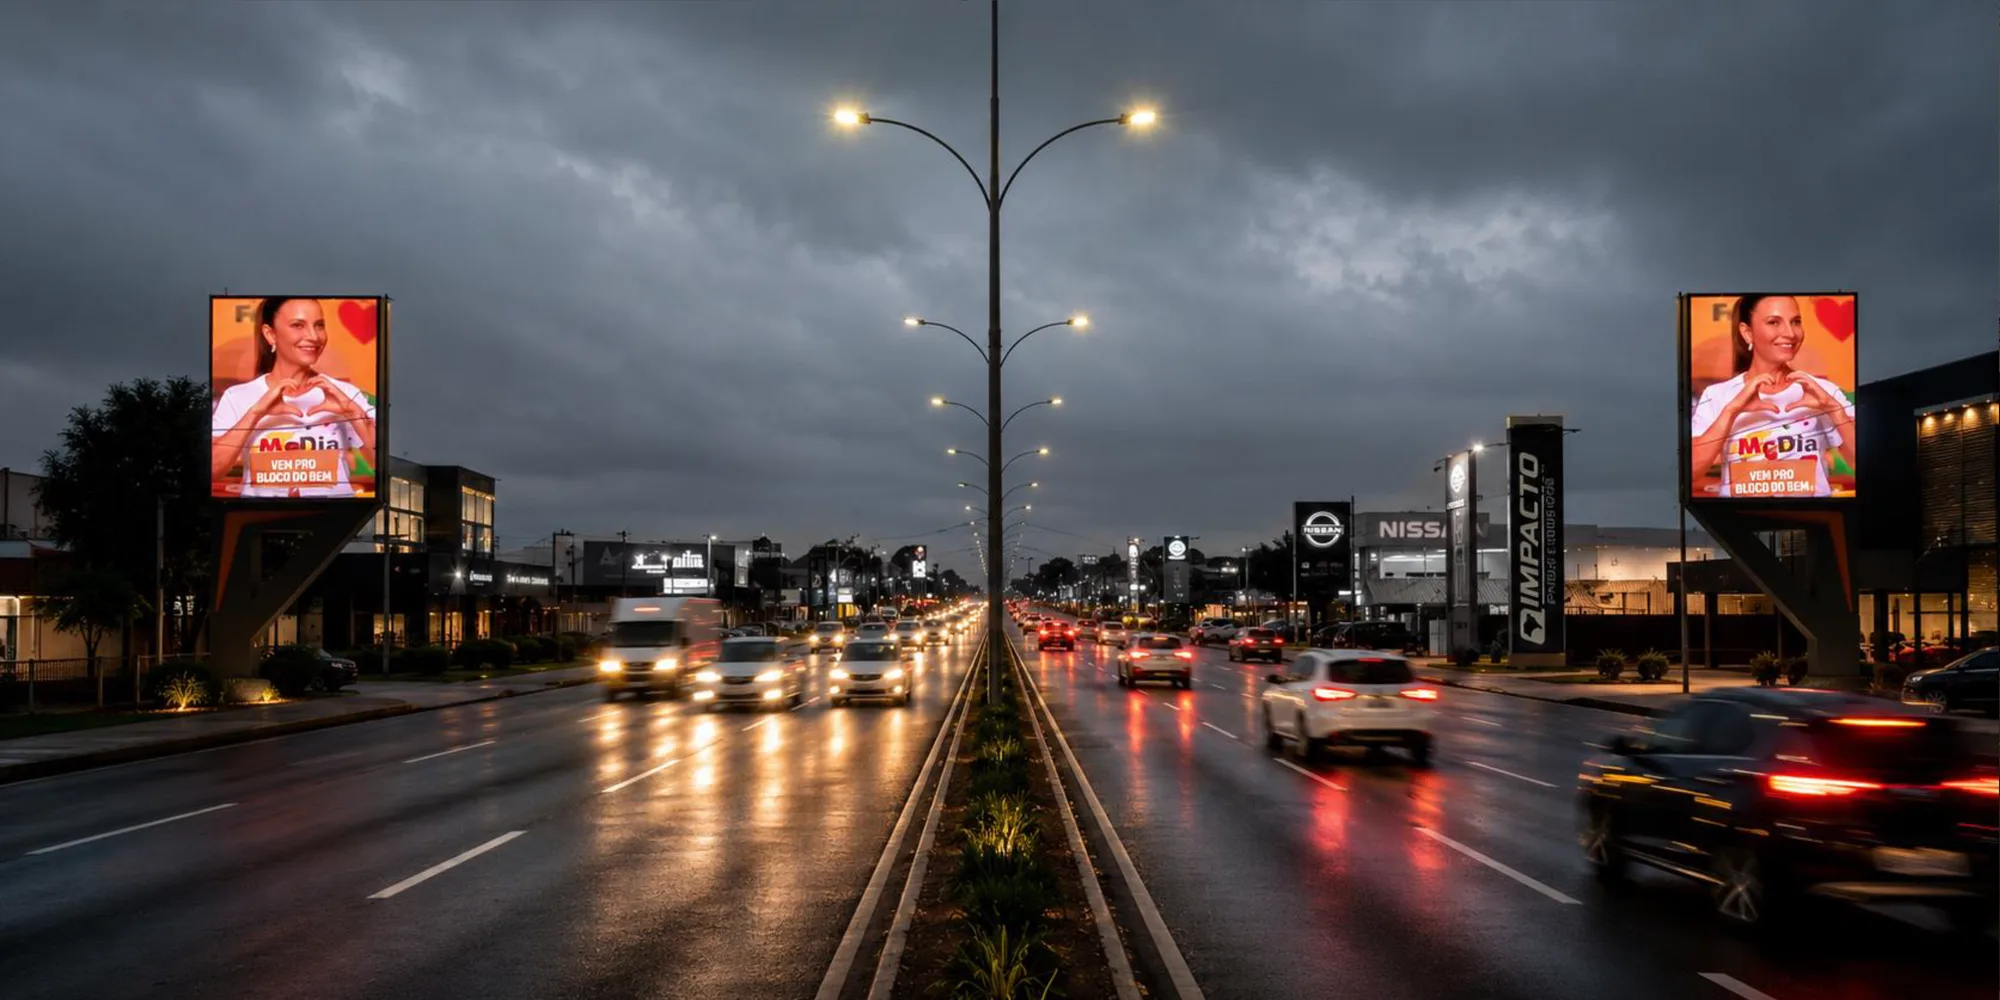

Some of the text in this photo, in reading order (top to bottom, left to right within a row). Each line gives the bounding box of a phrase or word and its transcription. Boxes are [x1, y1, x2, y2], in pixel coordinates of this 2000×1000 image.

[235, 305, 255, 322] F
[1712, 303, 1732, 321] F
[1738, 435, 1817, 460] McDia
[271, 459, 316, 470] VEM PRO
[256, 471, 332, 483] BLOCO DO BEM
[1749, 469, 1794, 481] VEM PRO
[1735, 483, 1769, 494] BLOCO
[1771, 482, 1784, 492] DO
[1379, 521, 1489, 538] NISSN
[1518, 451, 1540, 607] IMPACTO
